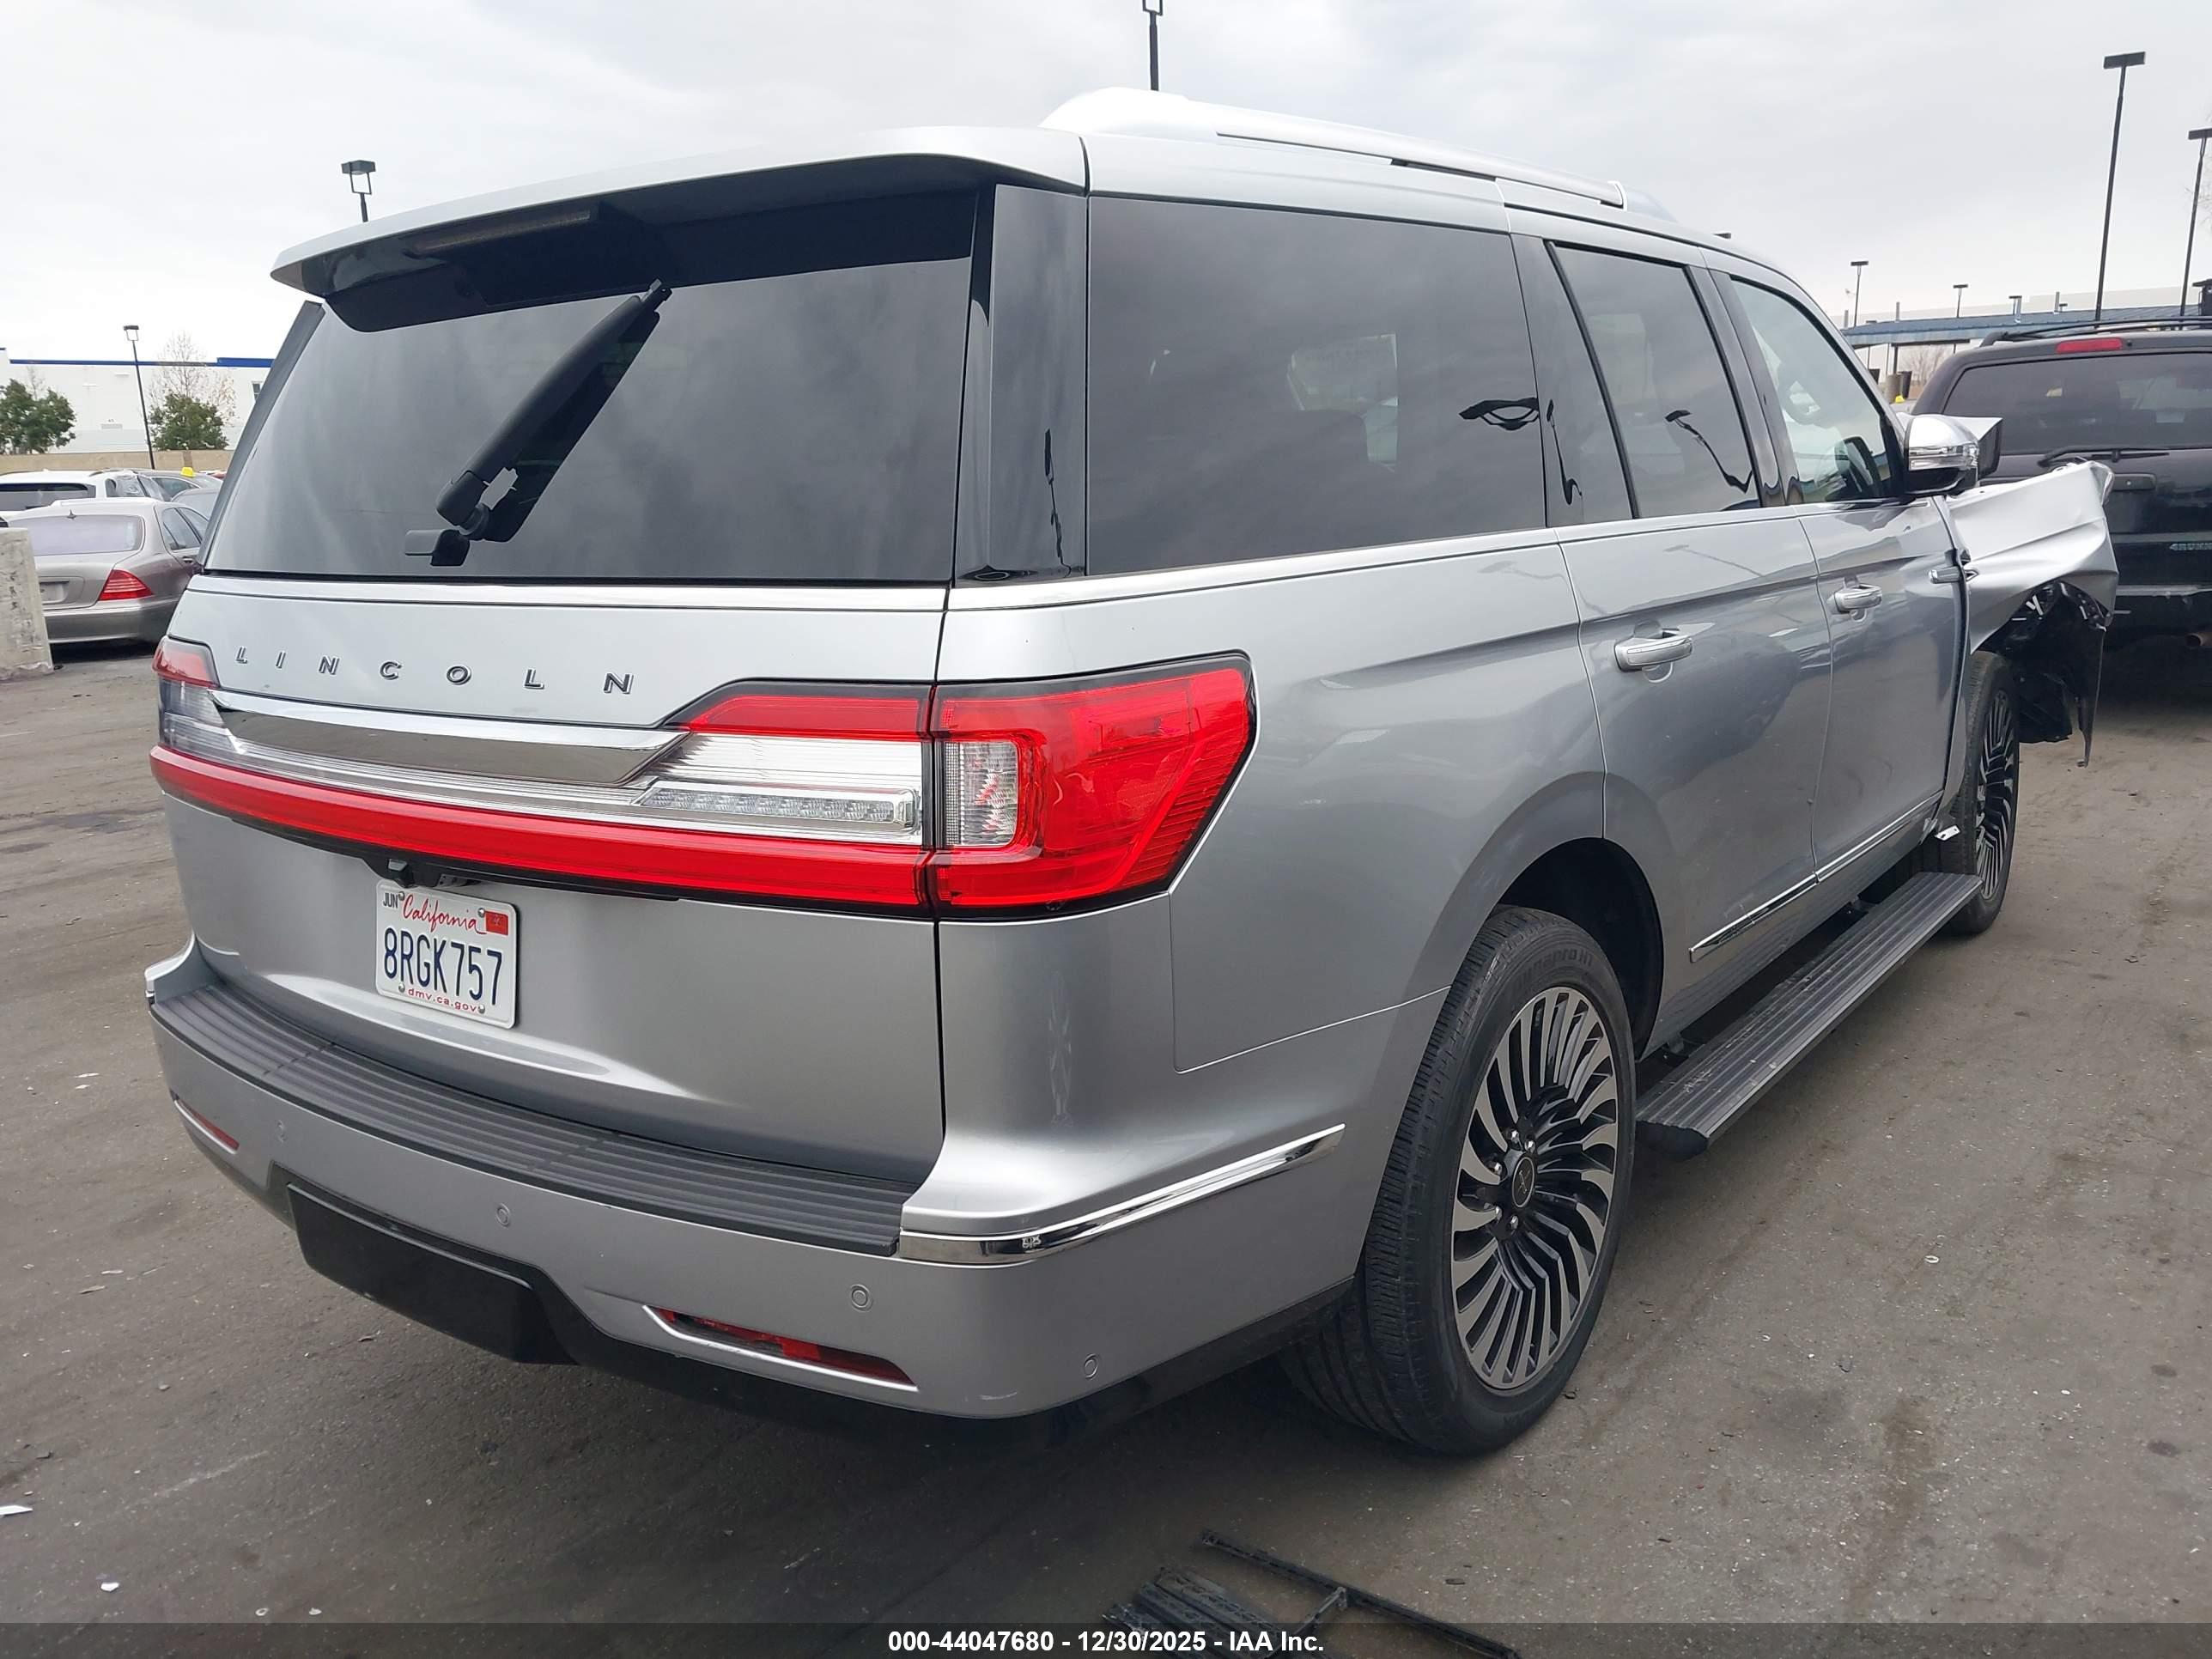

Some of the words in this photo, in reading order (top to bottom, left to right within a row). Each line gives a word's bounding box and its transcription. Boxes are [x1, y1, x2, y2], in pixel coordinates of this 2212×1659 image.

[235, 645, 634, 694] LINCOLN
[383, 892, 398, 908] JUN
[403, 894, 487, 933] California
[384, 927, 502, 1006] 8RGK757
[409, 988, 477, 1012] dmv.ca.gov
